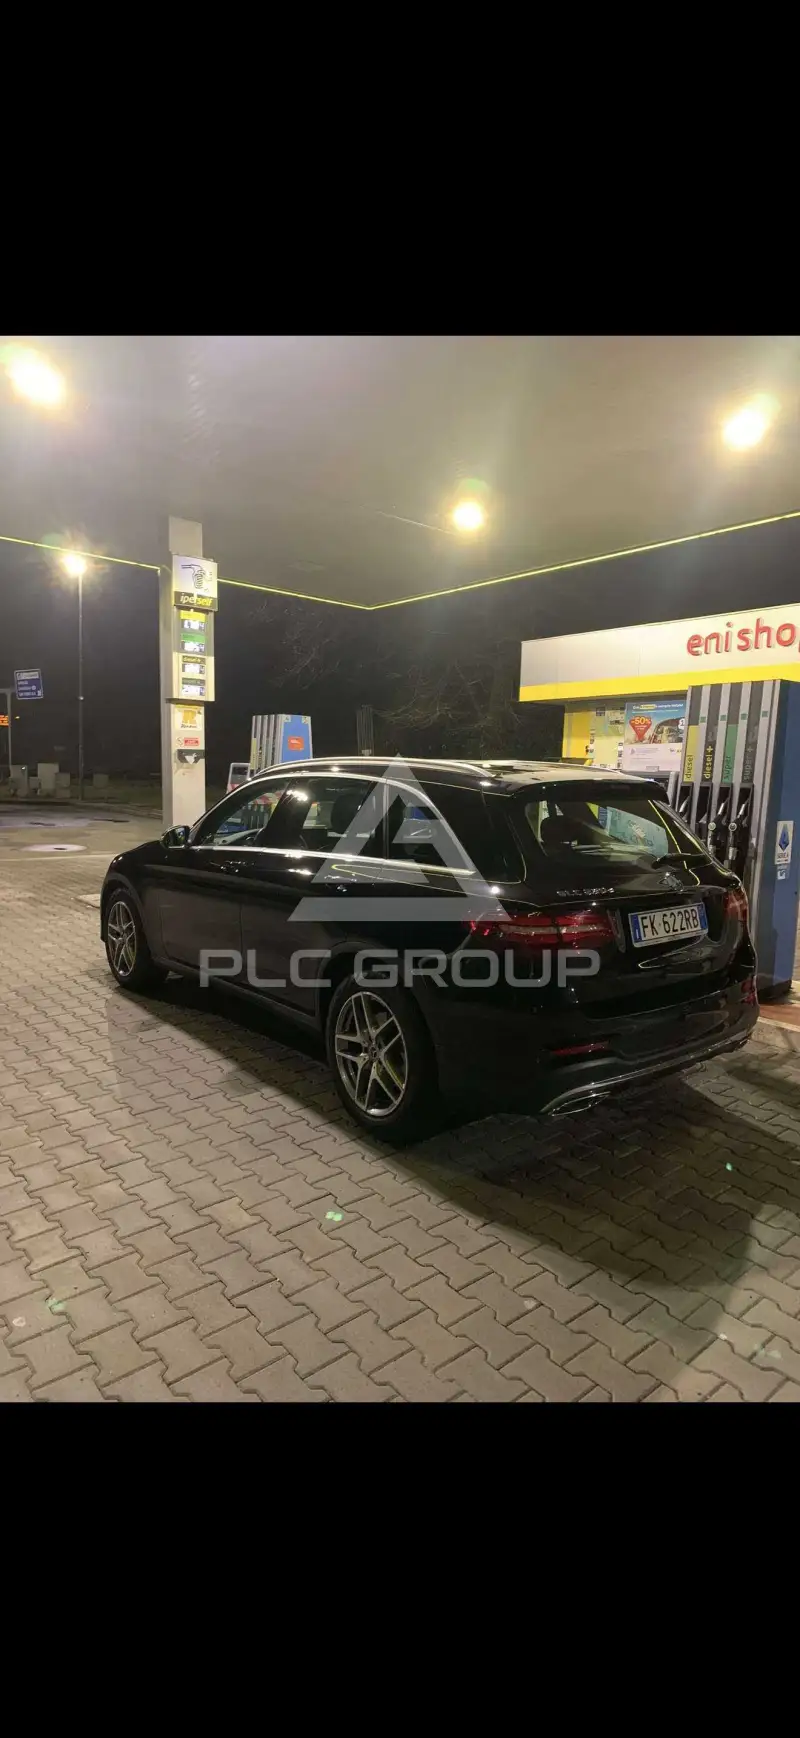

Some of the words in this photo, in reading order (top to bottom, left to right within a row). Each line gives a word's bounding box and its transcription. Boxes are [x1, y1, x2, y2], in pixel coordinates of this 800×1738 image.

[684, 754, 694, 779] diesel
[723, 755, 733, 780] super
[640, 914, 659, 938] FK
[662, 903, 699, 934] 622RB
